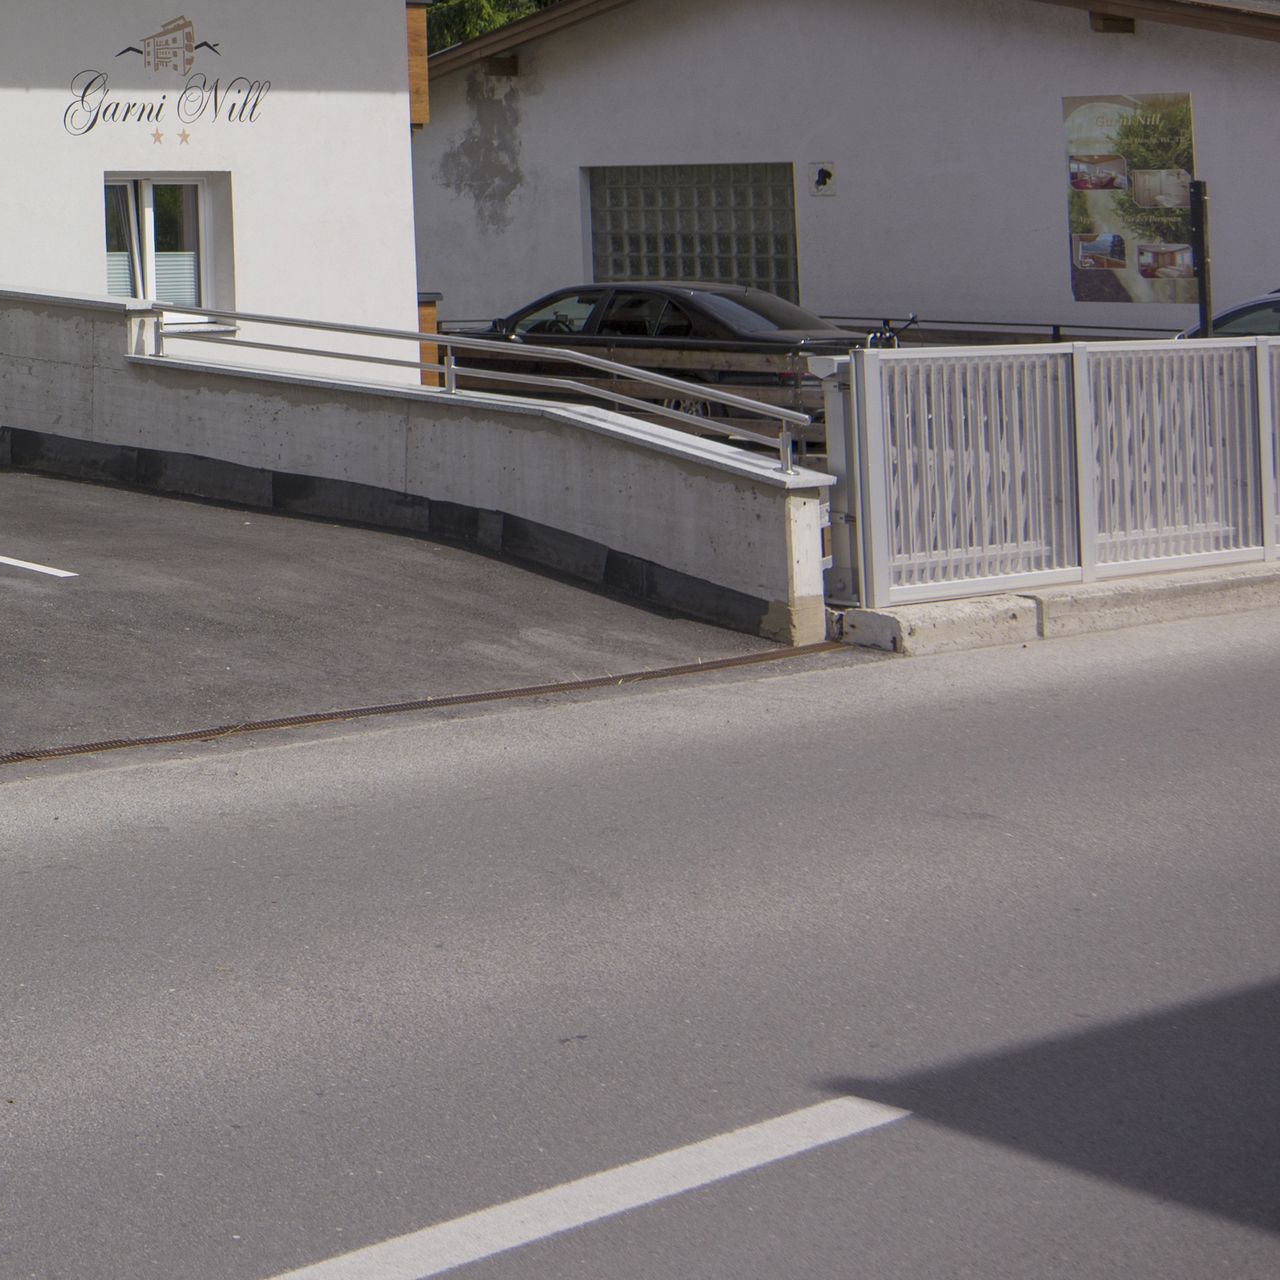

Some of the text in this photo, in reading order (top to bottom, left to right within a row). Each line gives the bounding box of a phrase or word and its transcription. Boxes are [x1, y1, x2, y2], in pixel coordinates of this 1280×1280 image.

[63, 69, 271, 136] Garni Nill
[1135, 113, 1161, 126] Nill
